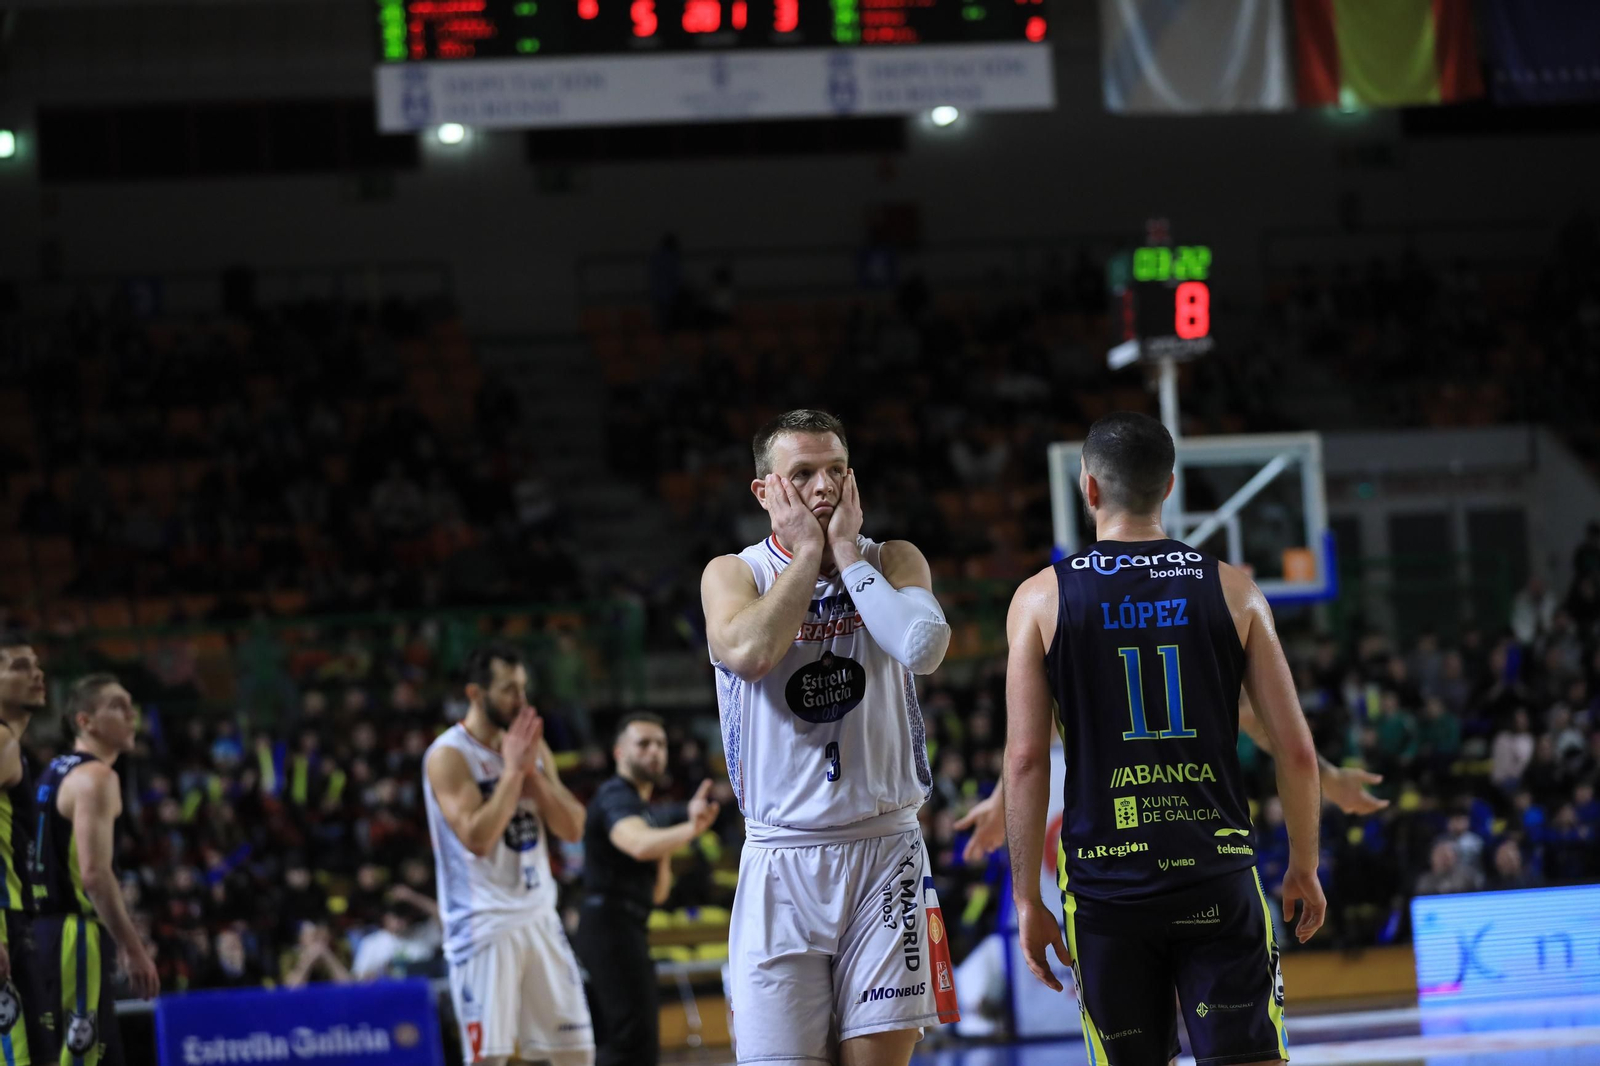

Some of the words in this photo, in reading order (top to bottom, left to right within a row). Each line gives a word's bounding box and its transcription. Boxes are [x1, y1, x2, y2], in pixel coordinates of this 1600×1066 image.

[1175, 281, 1210, 339] 8
[1071, 550, 1203, 575] aircargo
[1150, 567, 1203, 579] booking
[1101, 595, 1189, 630] LÓPEZ
[801, 668, 853, 690] Estrella
[803, 685, 852, 708] Galicia
[1118, 645, 1197, 741] 11
[825, 741, 840, 782] 3
[1119, 763, 1216, 788] ABANCA
[1142, 795, 1189, 809] XUNTA
[1143, 810, 1162, 823] DE
[1165, 808, 1221, 821] GALICIA
[1171, 858, 1195, 867] WIBO
[900, 879, 920, 972] MADRID
